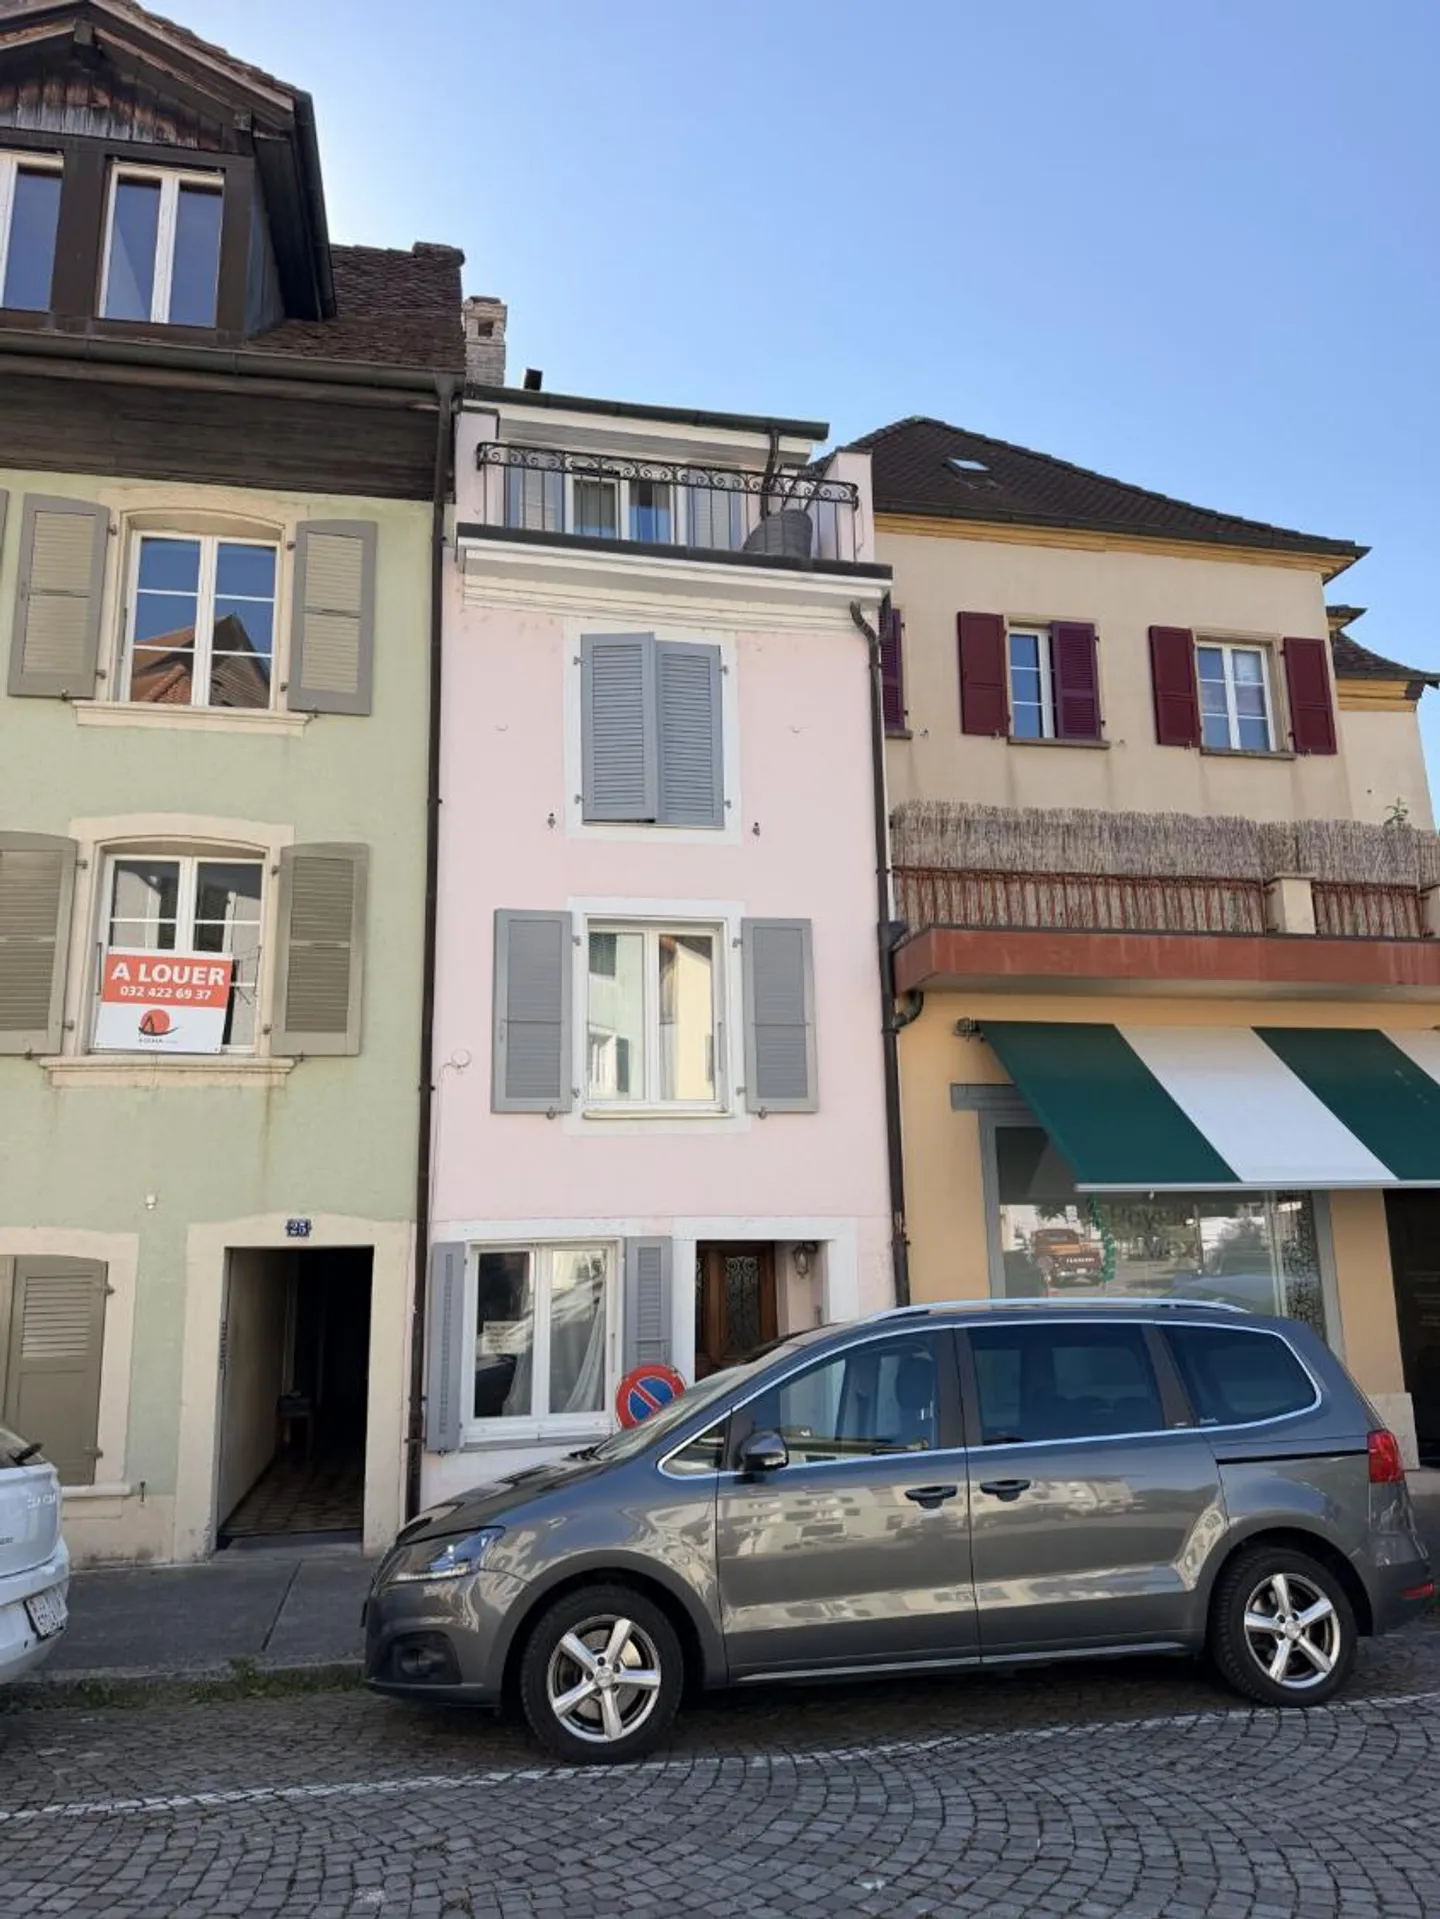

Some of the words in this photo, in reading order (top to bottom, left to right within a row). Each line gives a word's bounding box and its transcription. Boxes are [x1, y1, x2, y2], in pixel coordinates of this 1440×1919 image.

[111, 962, 130, 981] A
[138, 963, 225, 986] LOUER
[120, 986, 145, 997] 032
[148, 987, 173, 999] 422
[175, 988, 192, 999] 69
[195, 989, 212, 1000] 37
